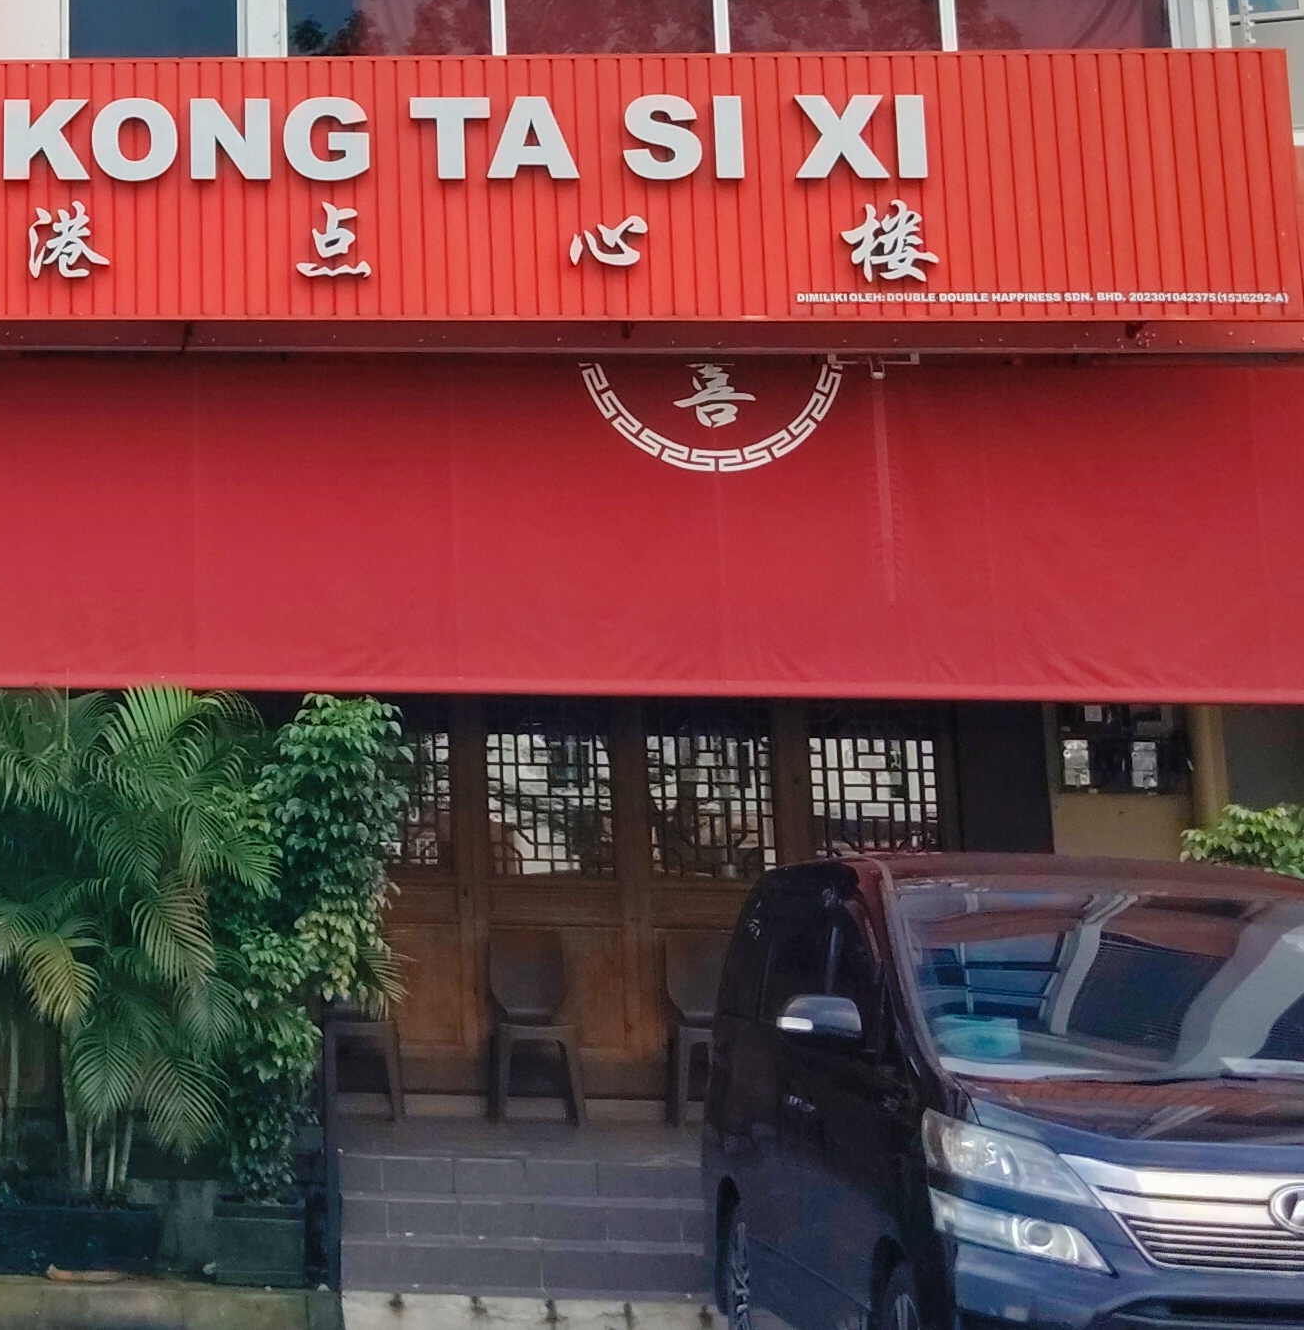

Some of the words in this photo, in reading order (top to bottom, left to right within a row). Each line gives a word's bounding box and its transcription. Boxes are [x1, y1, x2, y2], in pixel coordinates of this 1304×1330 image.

[2, 97, 371, 183] KONG
[409, 95, 581, 181] TA
[622, 94, 742, 181] SI
[792, 94, 928, 181] XI
[796, 292, 848, 303] DIMILIKI
[849, 292, 885, 303] OLEH:
[886, 292, 936, 303] DOUBLE
[939, 292, 989, 303] DOUBLE
[991, 292, 1062, 303] HAPPINESS
[1063, 292, 1094, 303] SDN.
[1096, 292, 1126, 303] BHD.
